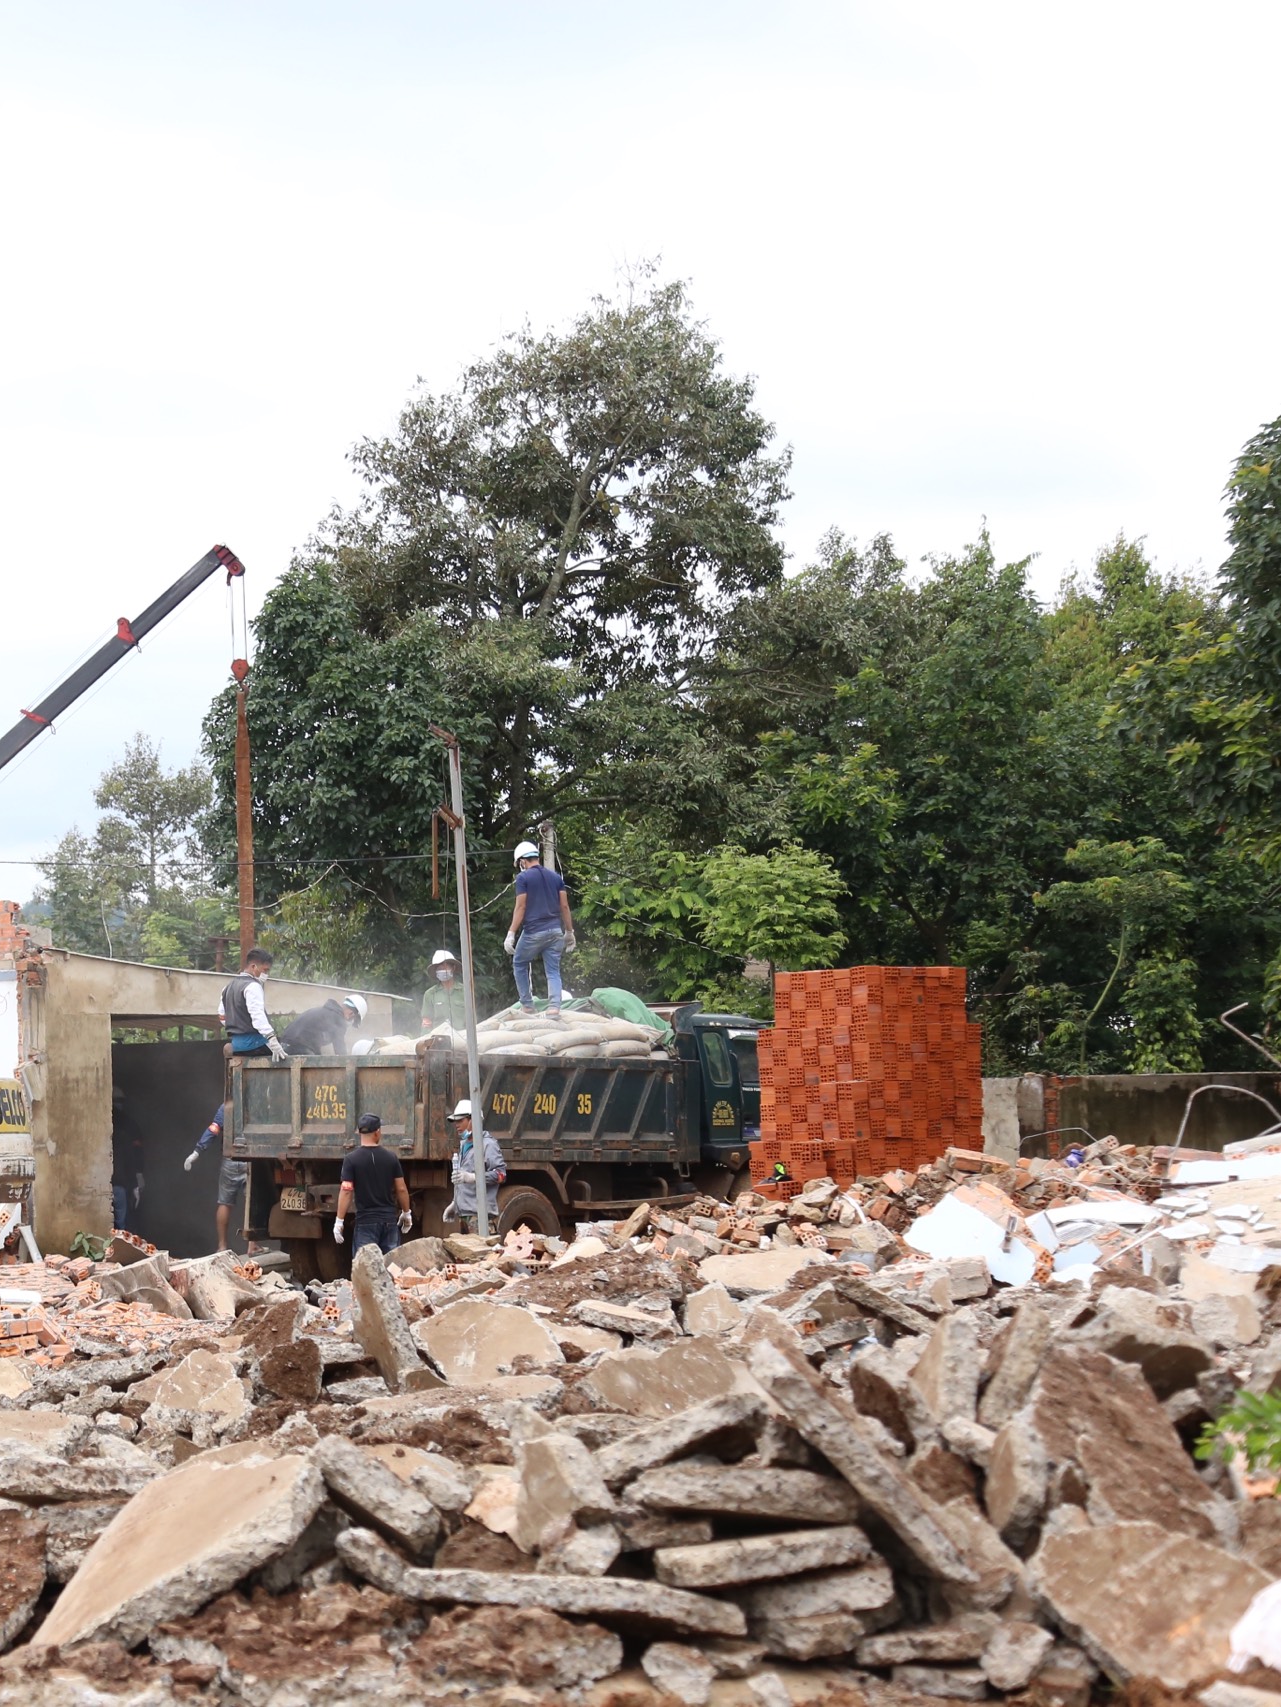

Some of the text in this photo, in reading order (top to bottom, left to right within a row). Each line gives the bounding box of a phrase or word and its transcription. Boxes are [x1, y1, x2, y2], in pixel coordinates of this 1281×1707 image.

[315, 1085, 337, 1102] 47C
[492, 1093, 592, 1115] 47C 240 35
